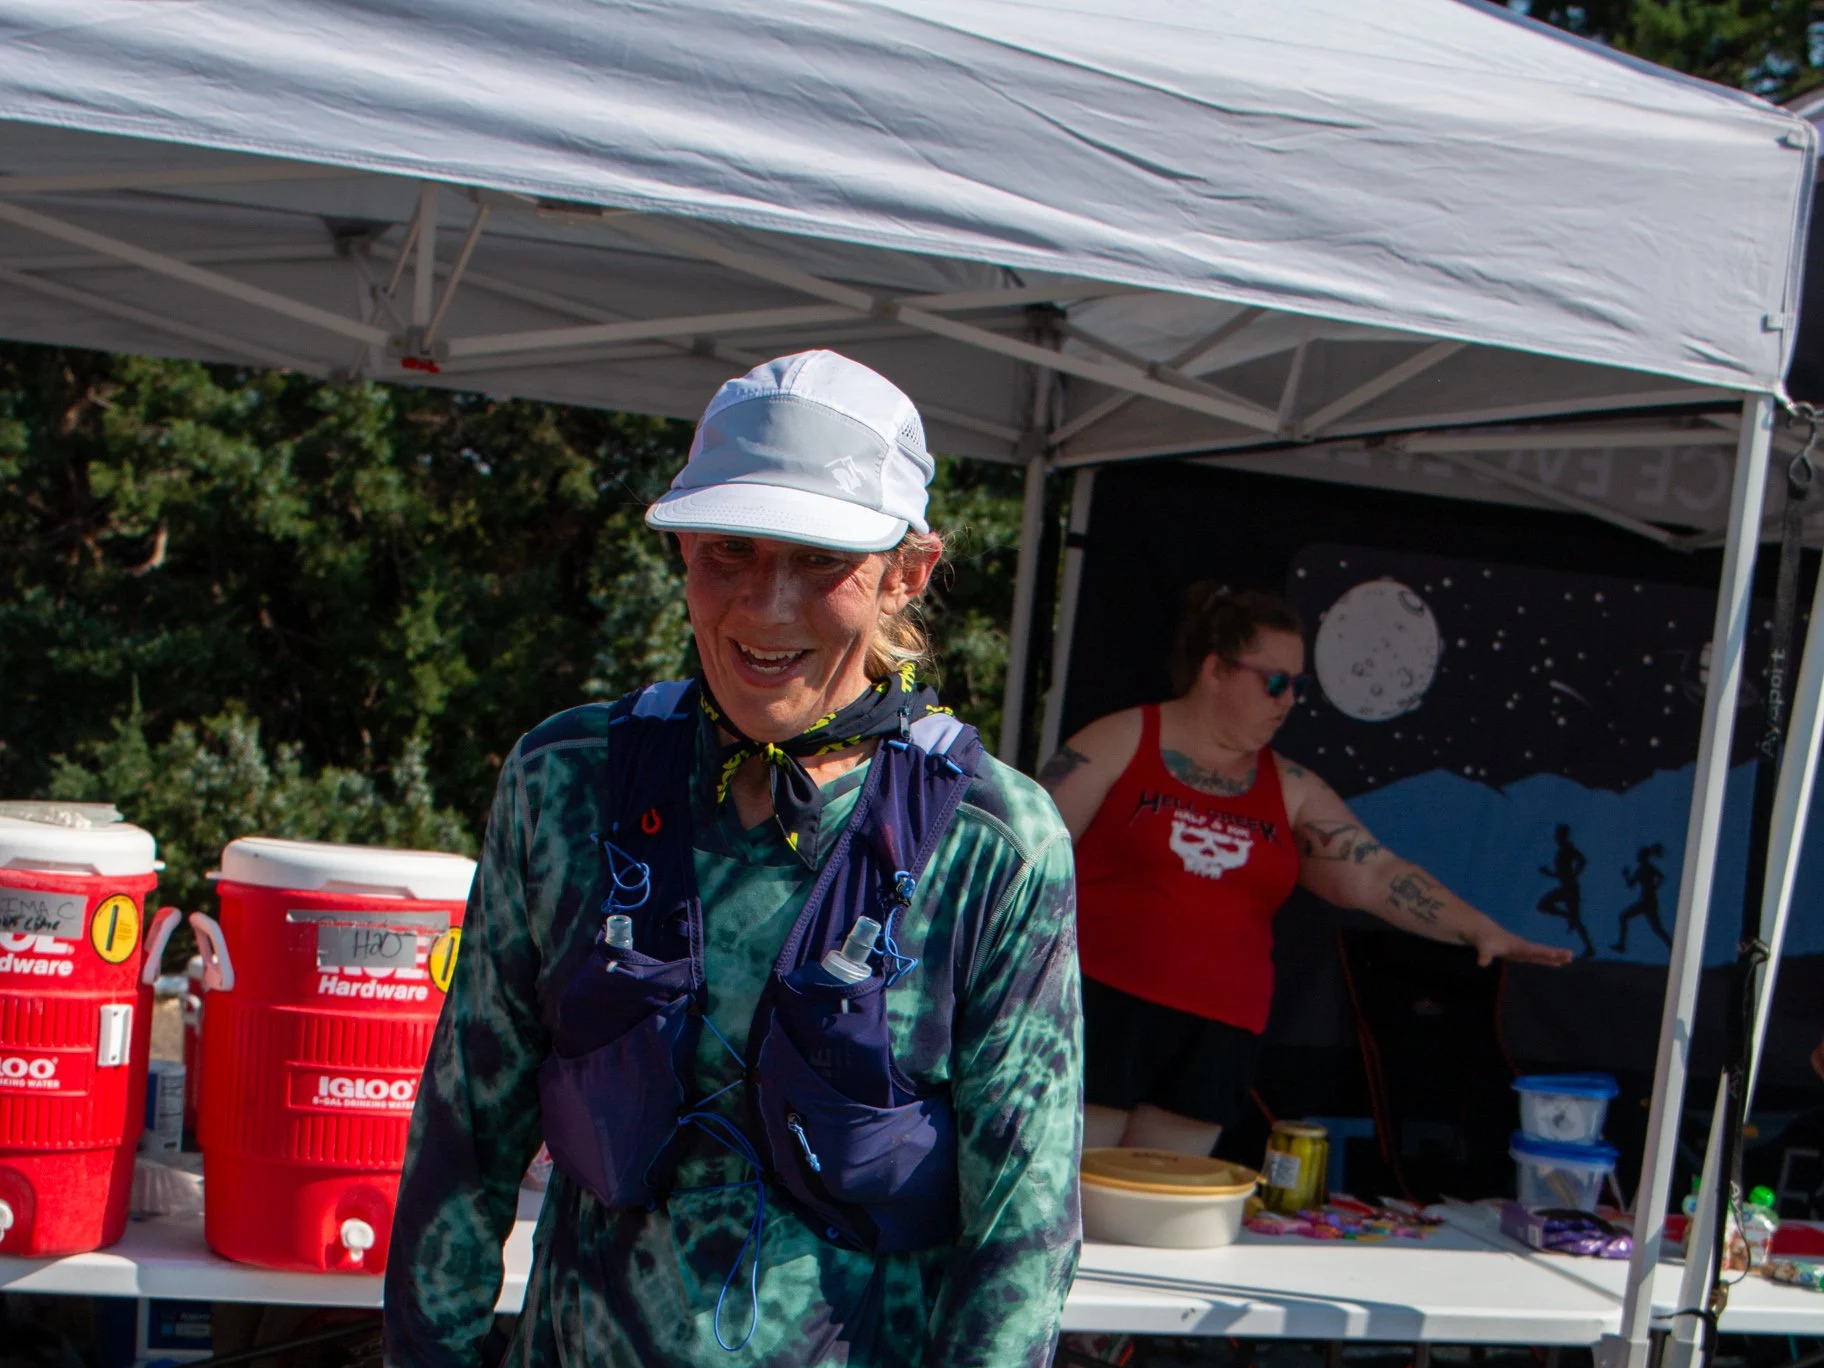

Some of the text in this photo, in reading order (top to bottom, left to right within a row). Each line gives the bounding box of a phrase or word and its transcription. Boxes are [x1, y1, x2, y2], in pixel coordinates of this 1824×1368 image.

[0, 953, 74, 977] dware
[318, 975, 428, 1001] Hardware
[319, 1075, 413, 1100] IGLOO
